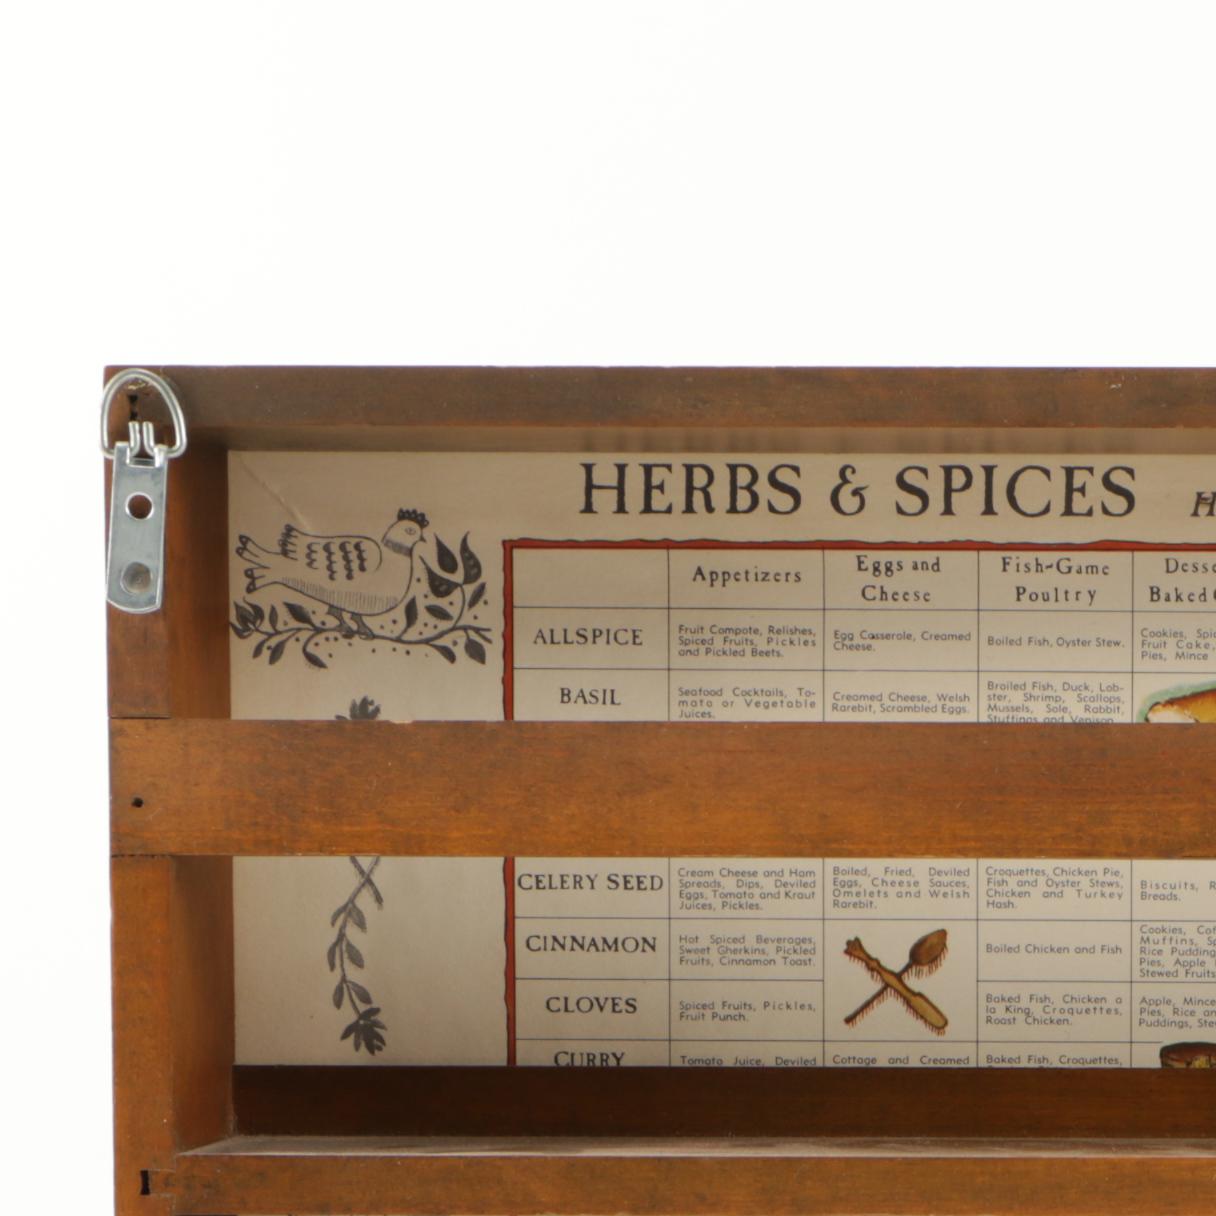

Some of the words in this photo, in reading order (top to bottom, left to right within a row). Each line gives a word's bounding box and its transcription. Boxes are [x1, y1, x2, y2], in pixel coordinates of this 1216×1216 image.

[579, 463, 802, 516] HERBS
[830, 464, 868, 516] &
[895, 464, 1135, 518] SPICES
[856, 554, 904, 578] Eggs
[912, 556, 940, 573] and
[692, 566, 802, 588] Appetizers
[861, 584, 930, 602] Cheese
[1015, 586, 1096, 606] Poultry
[1149, 586, 1207, 602] Baked
[533, 628, 643, 646] ALLSPICE
[678, 624, 704, 634] Fruit
[709, 624, 762, 637] Compote,
[768, 624, 813, 636] Relishes,
[1140, 627, 1187, 640] Cookies,
[678, 635, 714, 647] Spiced
[722, 635, 758, 647] Fruits,
[766, 636, 816, 647] Pickles
[1141, 639, 1167, 650] Fruit
[1175, 639, 1216, 651] Cake,
[678, 648, 700, 657] and
[704, 646, 746, 657] Pickled
[751, 647, 785, 658] Beets.
[1140, 650, 1167, 662] Pies,
[1175, 651, 1209, 661] Mince
[560, 687, 621, 706] BASIL
[517, 873, 598, 891] CELERY
[607, 873, 664, 891] SEED
[1140, 879, 1198, 892] Biscuits,
[1140, 890, 1182, 902] Breads.
[525, 935, 656, 953] CINNAMON
[986, 943, 1020, 954] Boiled
[1024, 943, 1070, 954] Chicken
[1074, 945, 1096, 954] and
[1100, 944, 1122, 955] Fish
[546, 996, 637, 1014] CLOVES
[679, 1000, 715, 1011] Spiced
[721, 1000, 756, 1012] Fruits,
[763, 1000, 816, 1012] Pickles,
[679, 1011, 706, 1021] Fruit
[711, 1011, 750, 1022] Punch.
